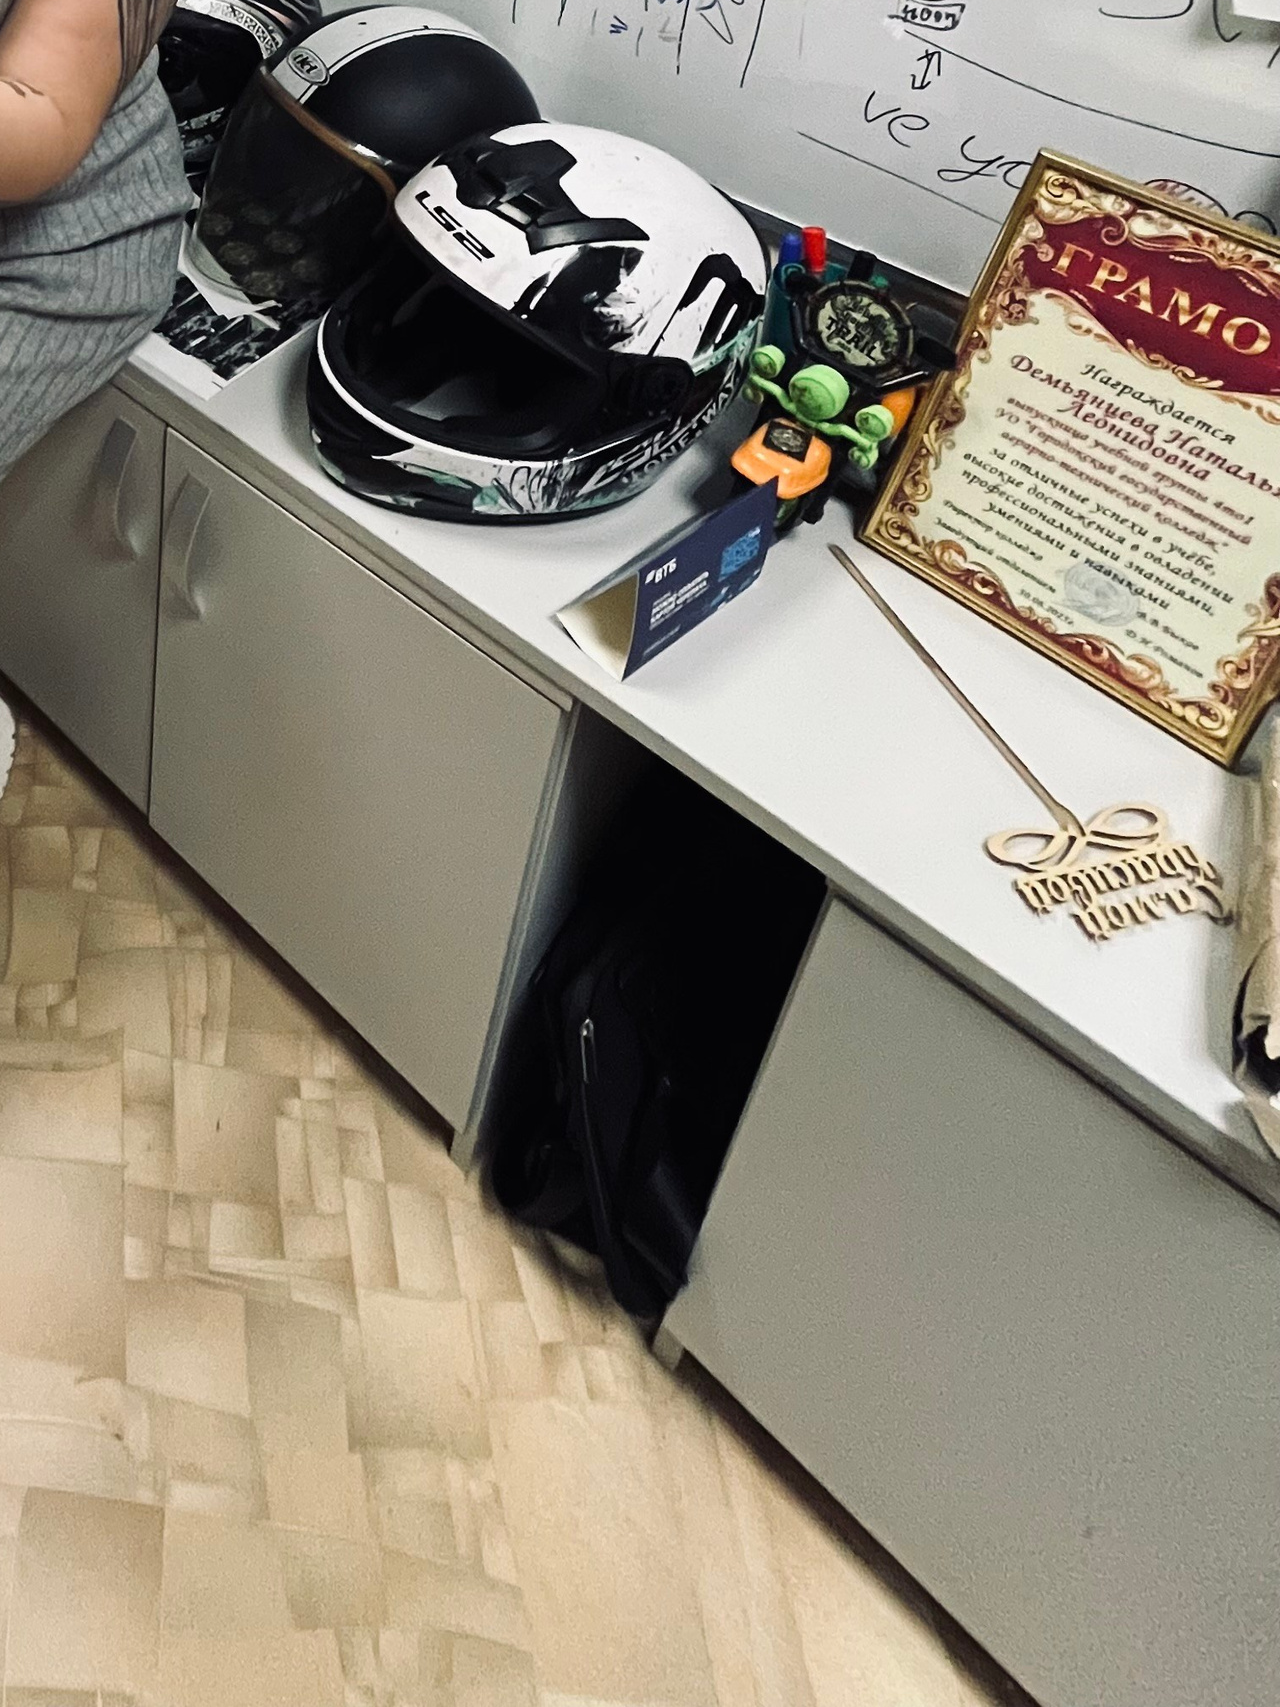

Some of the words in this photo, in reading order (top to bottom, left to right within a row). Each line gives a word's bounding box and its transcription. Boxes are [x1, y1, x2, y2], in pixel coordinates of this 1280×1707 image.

[414, 190, 496, 263] LS2
[824, 314, 878, 362] TRAIL
[1008, 352, 1159, 439] Демьянцева
[1057, 394, 1211, 484] Леонидовна
[1079, 360, 1236, 451] Награждается
[959, 468, 1124, 562] профессиональными
[990, 447, 1007, 460] за
[1010, 459, 1090, 505] отличные
[1089, 501, 1149, 539] успехи
[1153, 535, 1163, 543] в
[999, 430, 1152, 515] аграрно-технический
[1117, 471, 1252, 547] государственный
[655, 557, 677, 584] ВТБ
[962, 452, 1025, 490] высокие
[1025, 483, 1129, 545] достижения
[1130, 542, 1140, 552] в
[1142, 548, 1236, 604] овладении
[982, 501, 1067, 550] умениями
[1070, 549, 1079, 558] и
[1082, 558, 1171, 611] навыками
